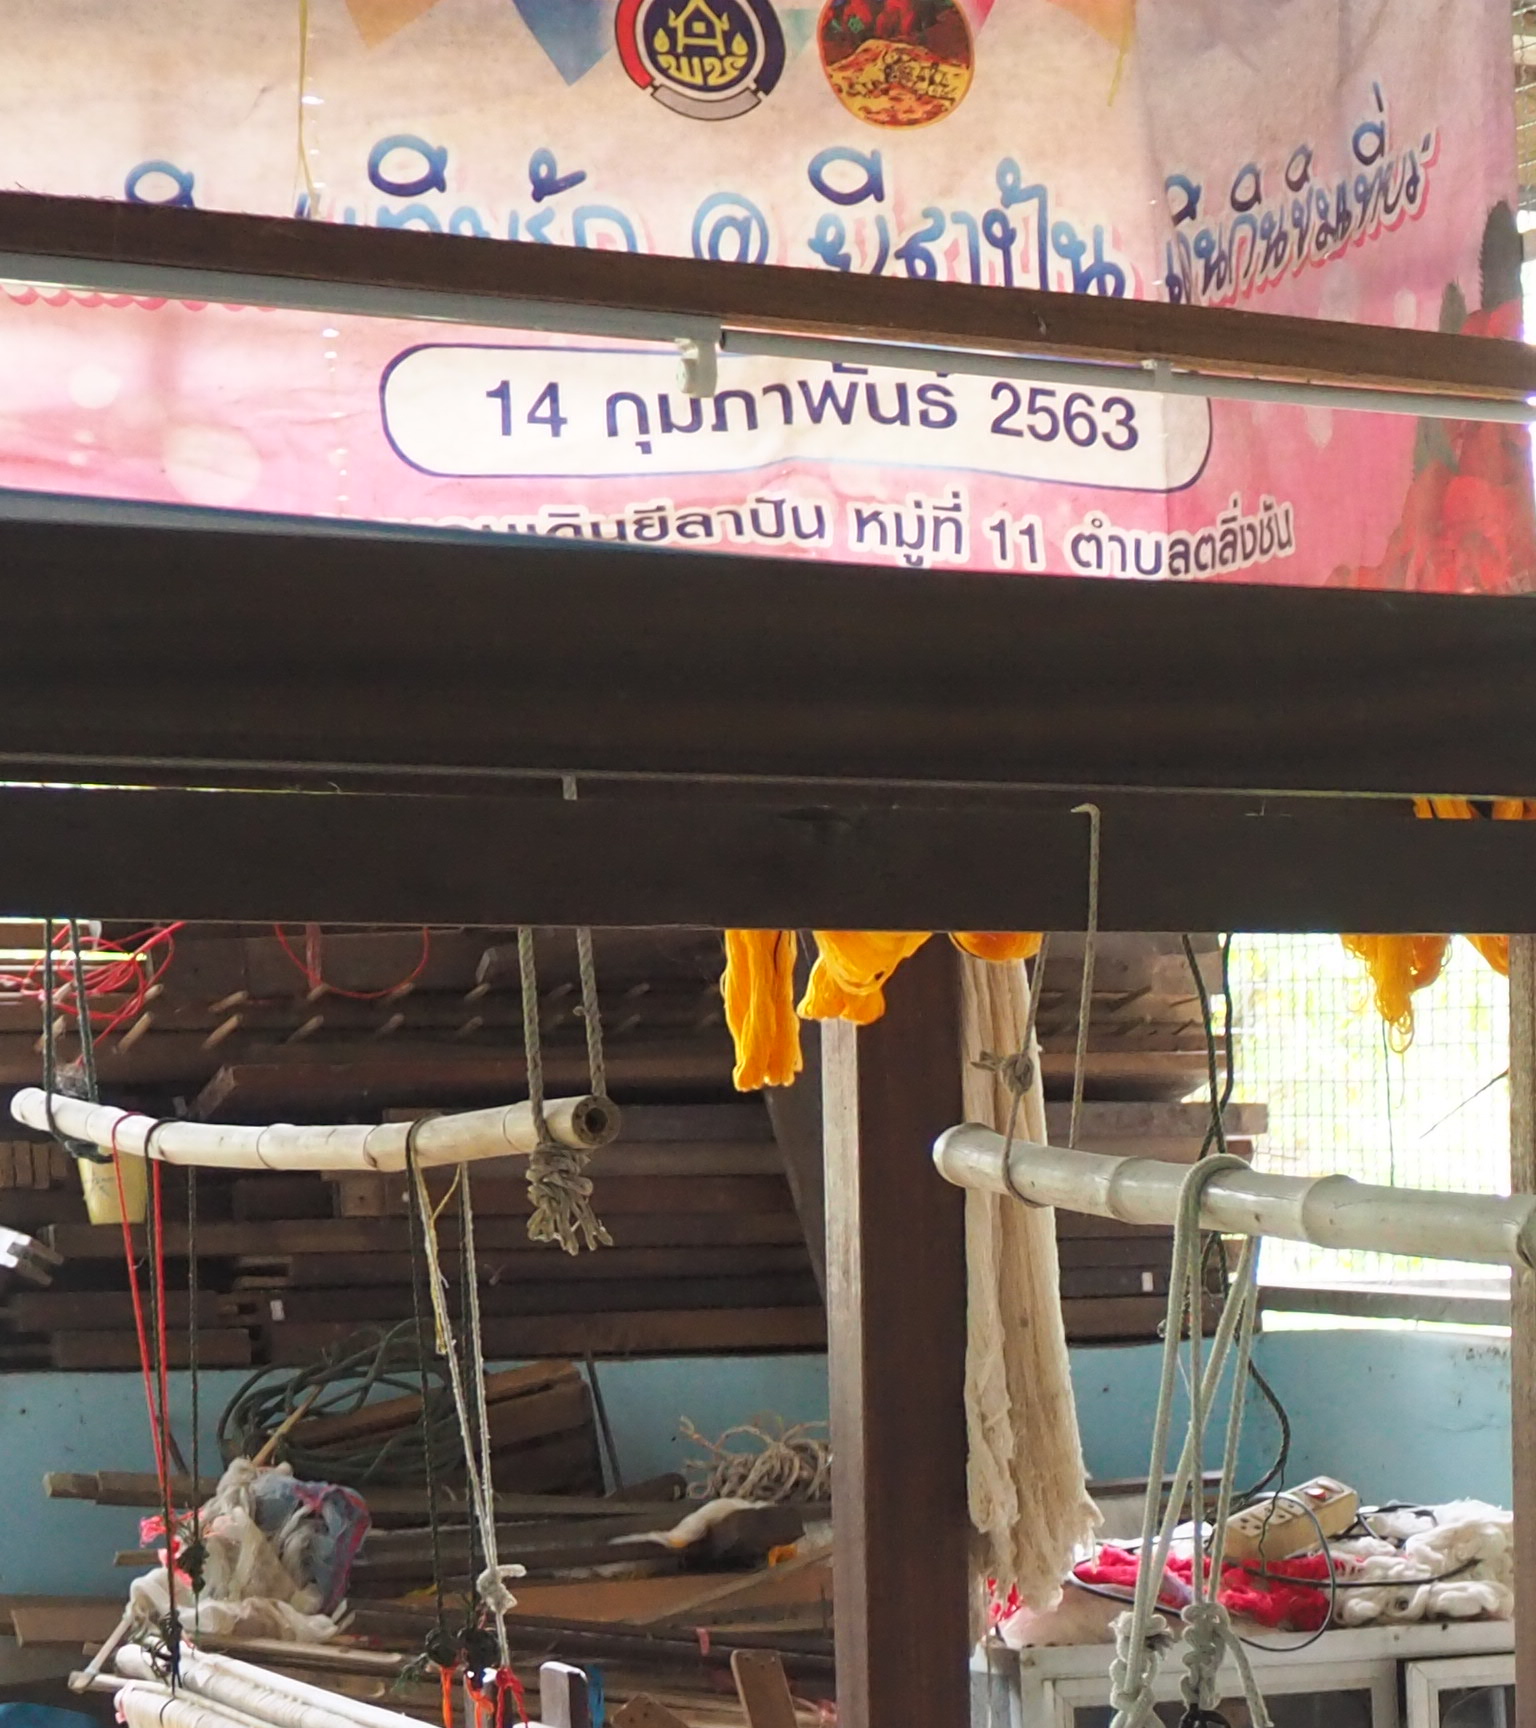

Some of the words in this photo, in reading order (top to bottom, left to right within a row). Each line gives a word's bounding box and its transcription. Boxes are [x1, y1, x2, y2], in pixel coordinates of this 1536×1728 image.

[691, 192, 769, 264] @
[485, 380, 569, 438] 14
[605, 362, 958, 454] กุมภาพันธ
[990, 380, 1140, 451] 2563
[854, 491, 963, 568] หมู่ที่
[989, 519, 1038, 563] 11
[1071, 499, 1294, 577] ตำบลตลิ่งชัน
